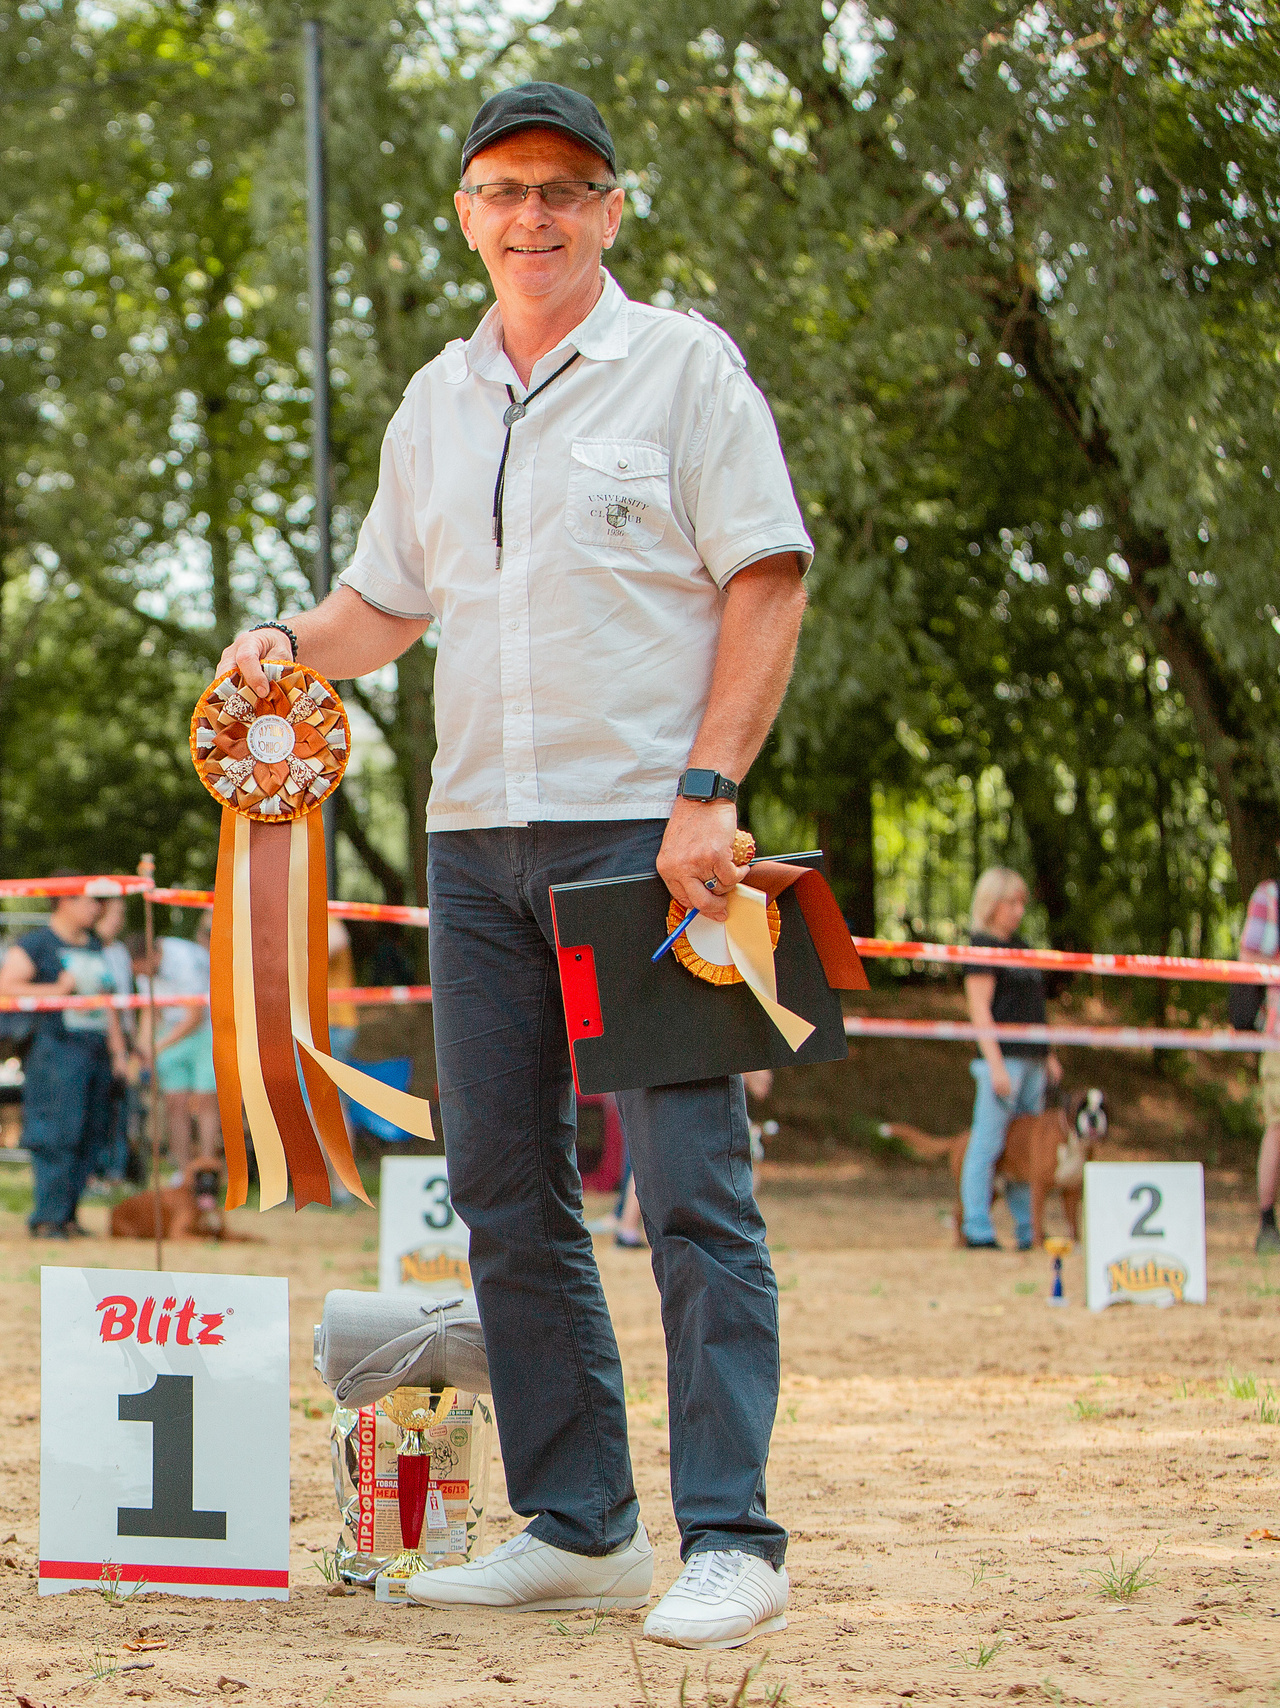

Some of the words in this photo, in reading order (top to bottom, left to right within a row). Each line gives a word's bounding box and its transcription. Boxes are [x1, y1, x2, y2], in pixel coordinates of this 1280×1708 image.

[588, 494, 649, 511] UNIVERSITY
[423, 1178, 454, 1229] 3
[1129, 1185, 1164, 1237] 2
[95, 1294, 227, 1347] Blitz
[117, 1374, 227, 1540] 1
[442, 1485, 466, 1494] 26/15
